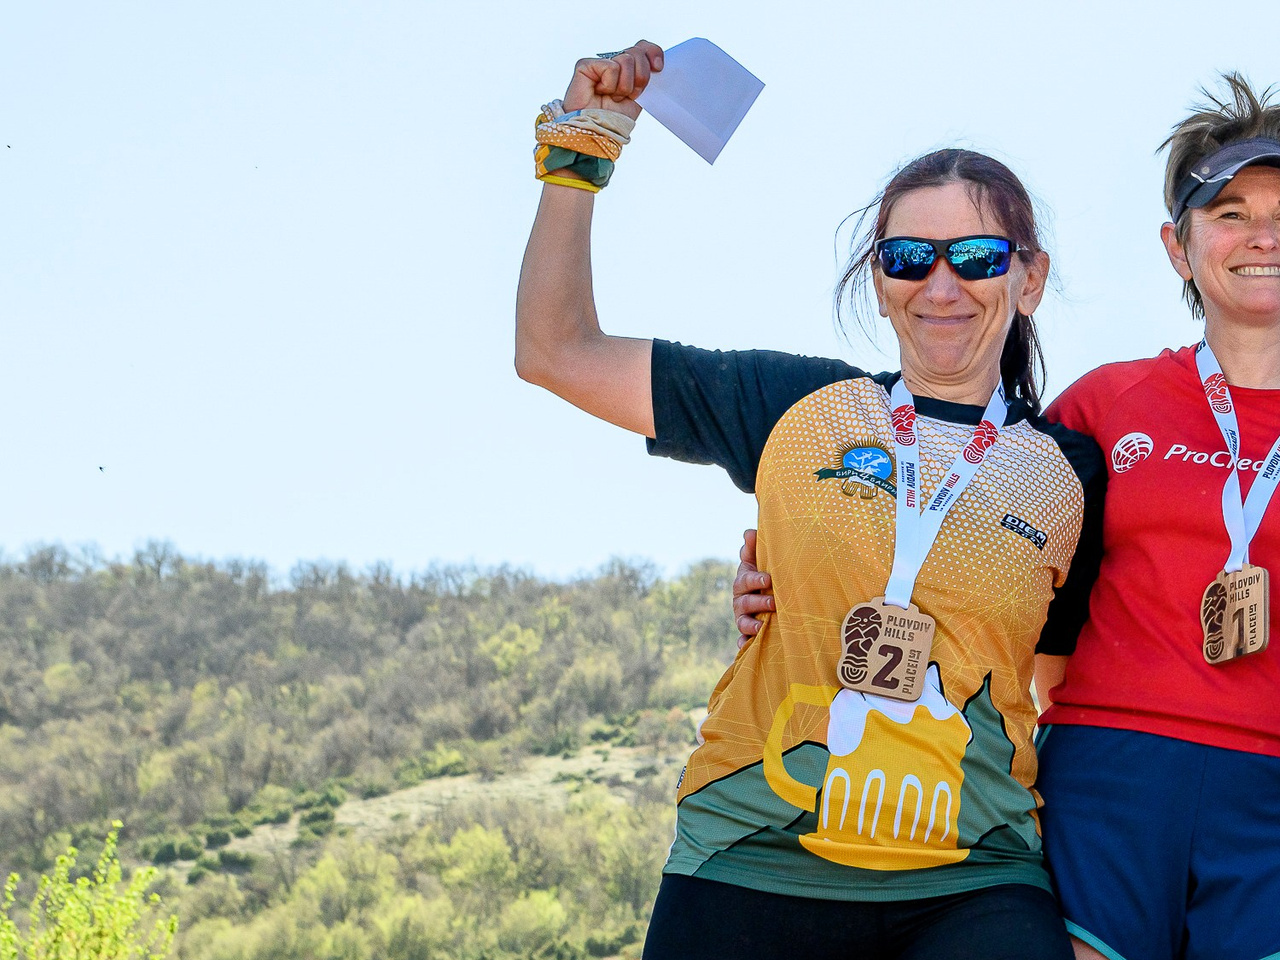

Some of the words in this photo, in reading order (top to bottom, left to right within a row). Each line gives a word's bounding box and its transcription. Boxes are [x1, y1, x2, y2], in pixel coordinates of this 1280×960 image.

[1229, 573, 1261, 592] PLOVDIV
[1230, 588, 1250, 604] HILLS
[886, 615, 931, 633] PLOVDIV
[1232, 607, 1245, 656] 1
[884, 627, 915, 642] HILLS
[871, 644, 904, 690] 2
